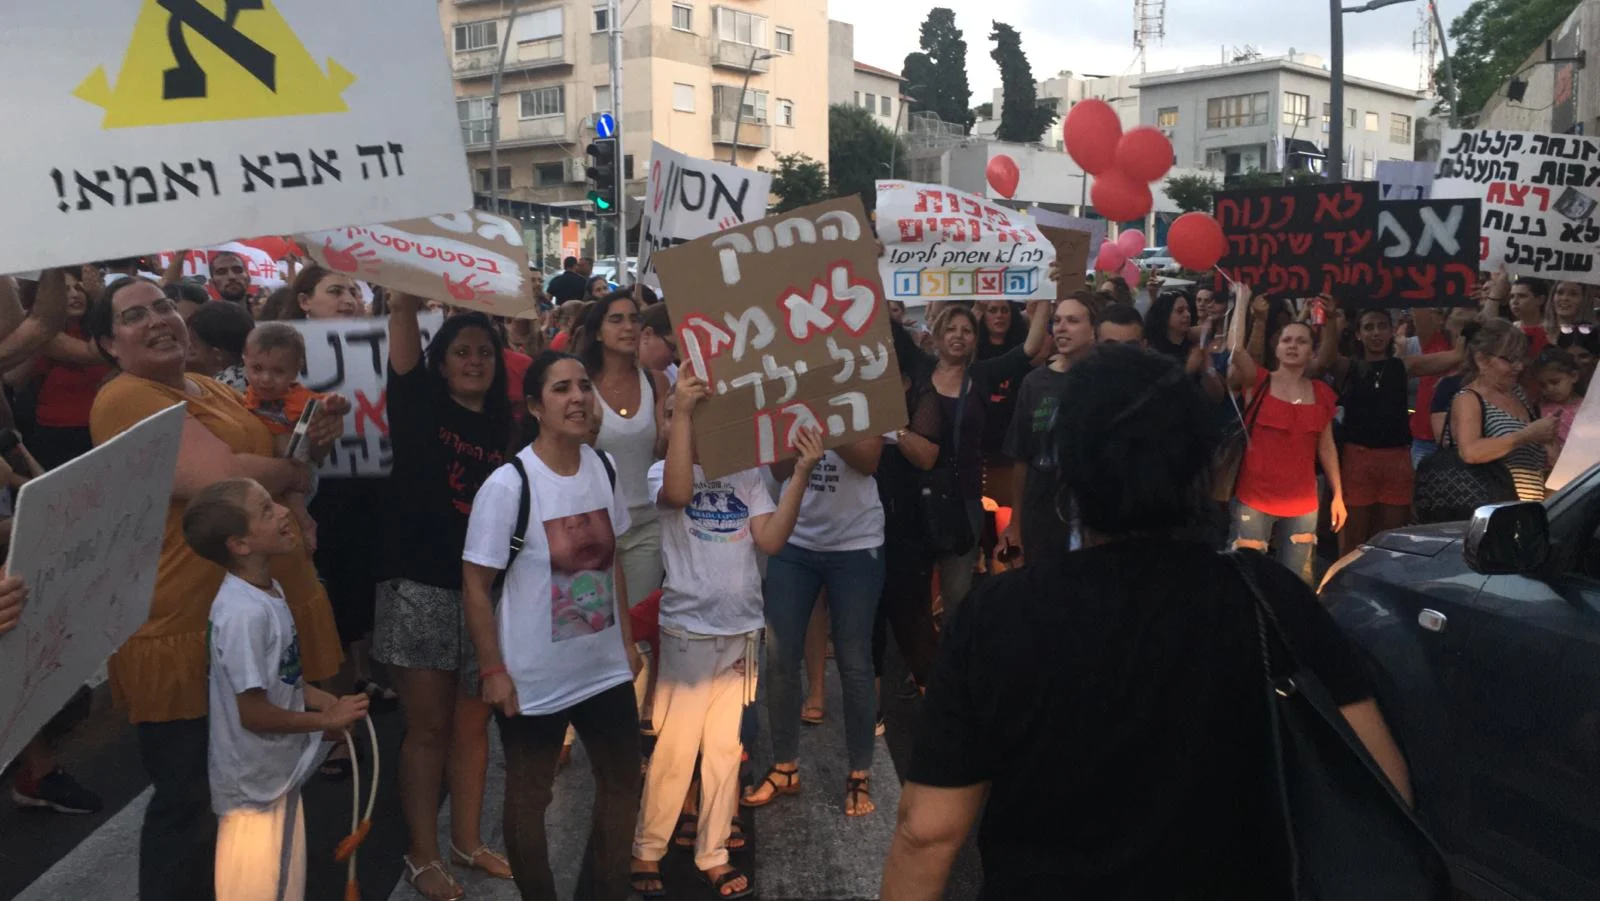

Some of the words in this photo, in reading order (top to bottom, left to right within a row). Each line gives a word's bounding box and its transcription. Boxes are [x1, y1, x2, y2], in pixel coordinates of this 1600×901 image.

[356, 142, 404, 181] זה
[1447, 130, 1523, 158] קללות
[1521, 134, 1600, 161] זנחה,
[50, 158, 221, 213] ואמא!
[240, 148, 342, 193] אבא
[1217, 196, 1295, 230] ננוח
[1314, 184, 1364, 222] לא
[1486, 181, 1550, 211] רצח
[1483, 209, 1547, 237] ננוח
[1560, 218, 1600, 242] לא
[336, 226, 502, 274] בסטטיסטיק
[712, 210, 861, 285] החוק
[890, 242, 942, 263] ילדים!
[941, 249, 989, 266] משחק
[996, 242, 1022, 263] לא
[1324, 229, 1374, 255] עד
[1504, 236, 1593, 272] שנקבל
[1321, 260, 1373, 294] חוק
[780, 262, 878, 341] לא
[678, 305, 776, 389] מגן
[826, 337, 888, 384] על
[717, 355, 808, 410] ילדי
[756, 391, 869, 463] הגן
